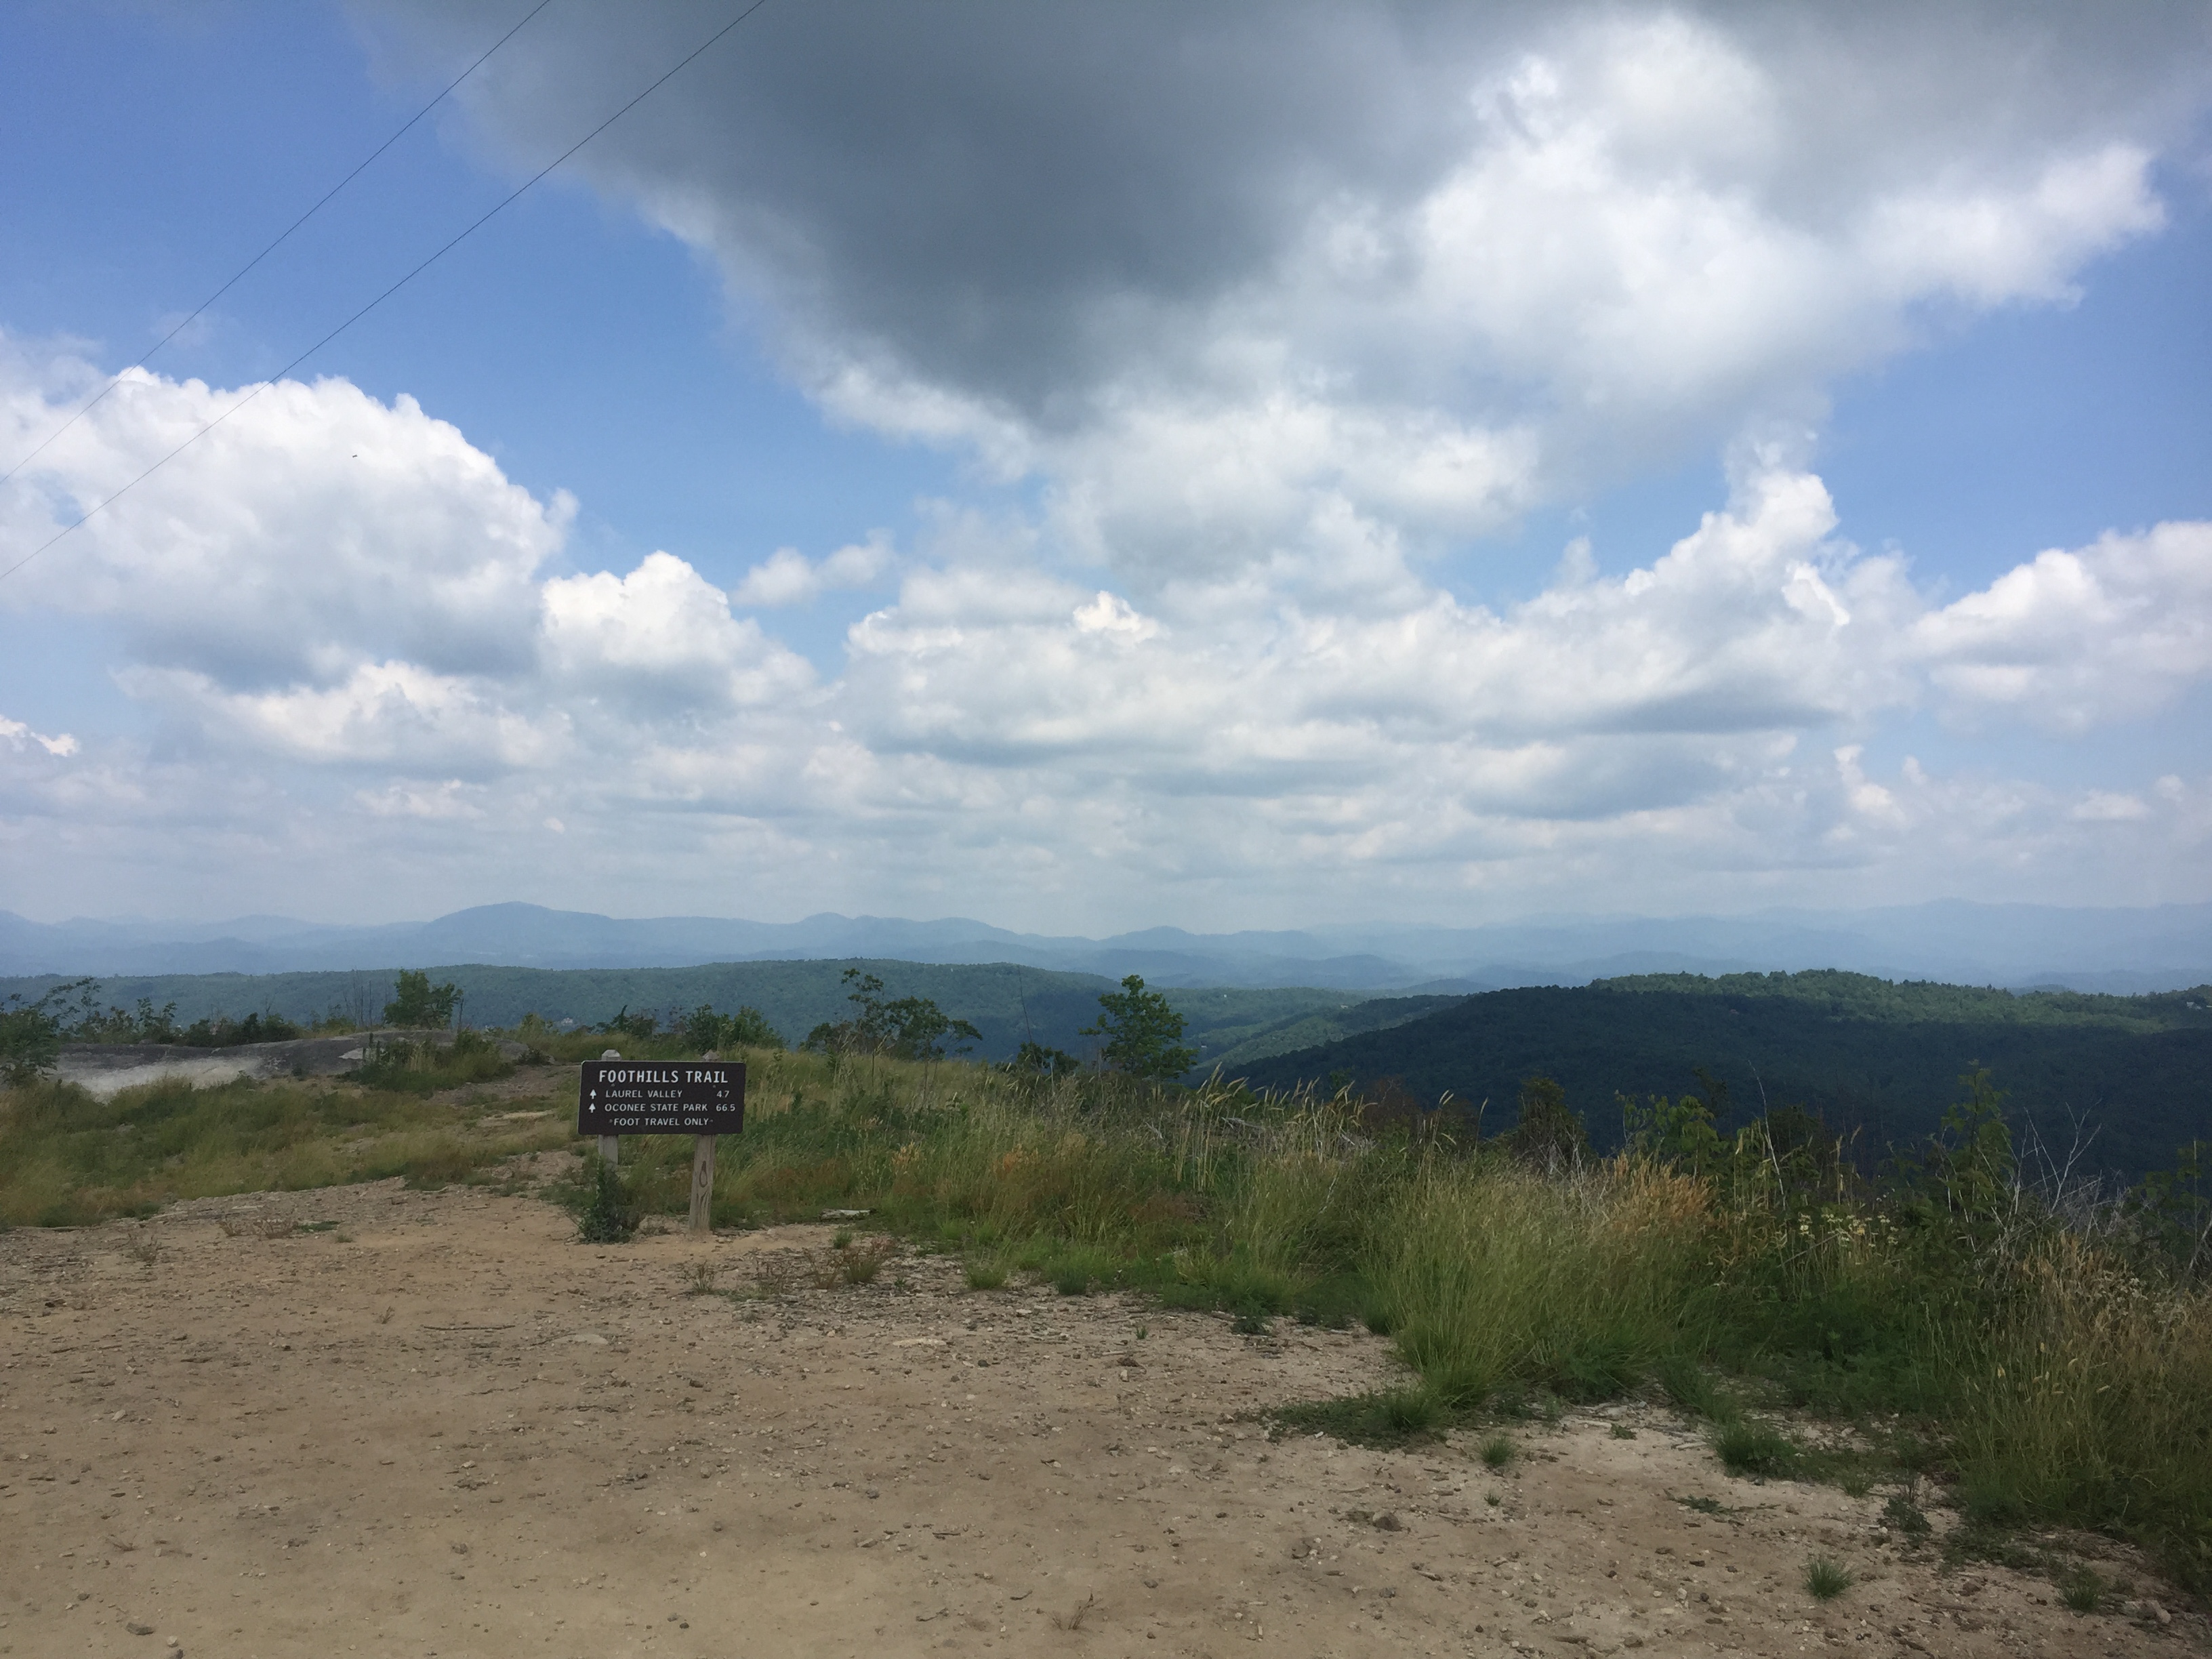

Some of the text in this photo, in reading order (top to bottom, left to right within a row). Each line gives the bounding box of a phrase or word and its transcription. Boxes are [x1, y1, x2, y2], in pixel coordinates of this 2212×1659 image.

[599, 1069, 729, 1083] FOOTHILLS TRAIL
[605, 1090, 730, 1098] LAUREL VALLEY 4.7
[605, 1103, 735, 1111] OCONEE STATE PARK 66.5
[613, 1118, 709, 1126] FOOT TRAVEL ONLY
